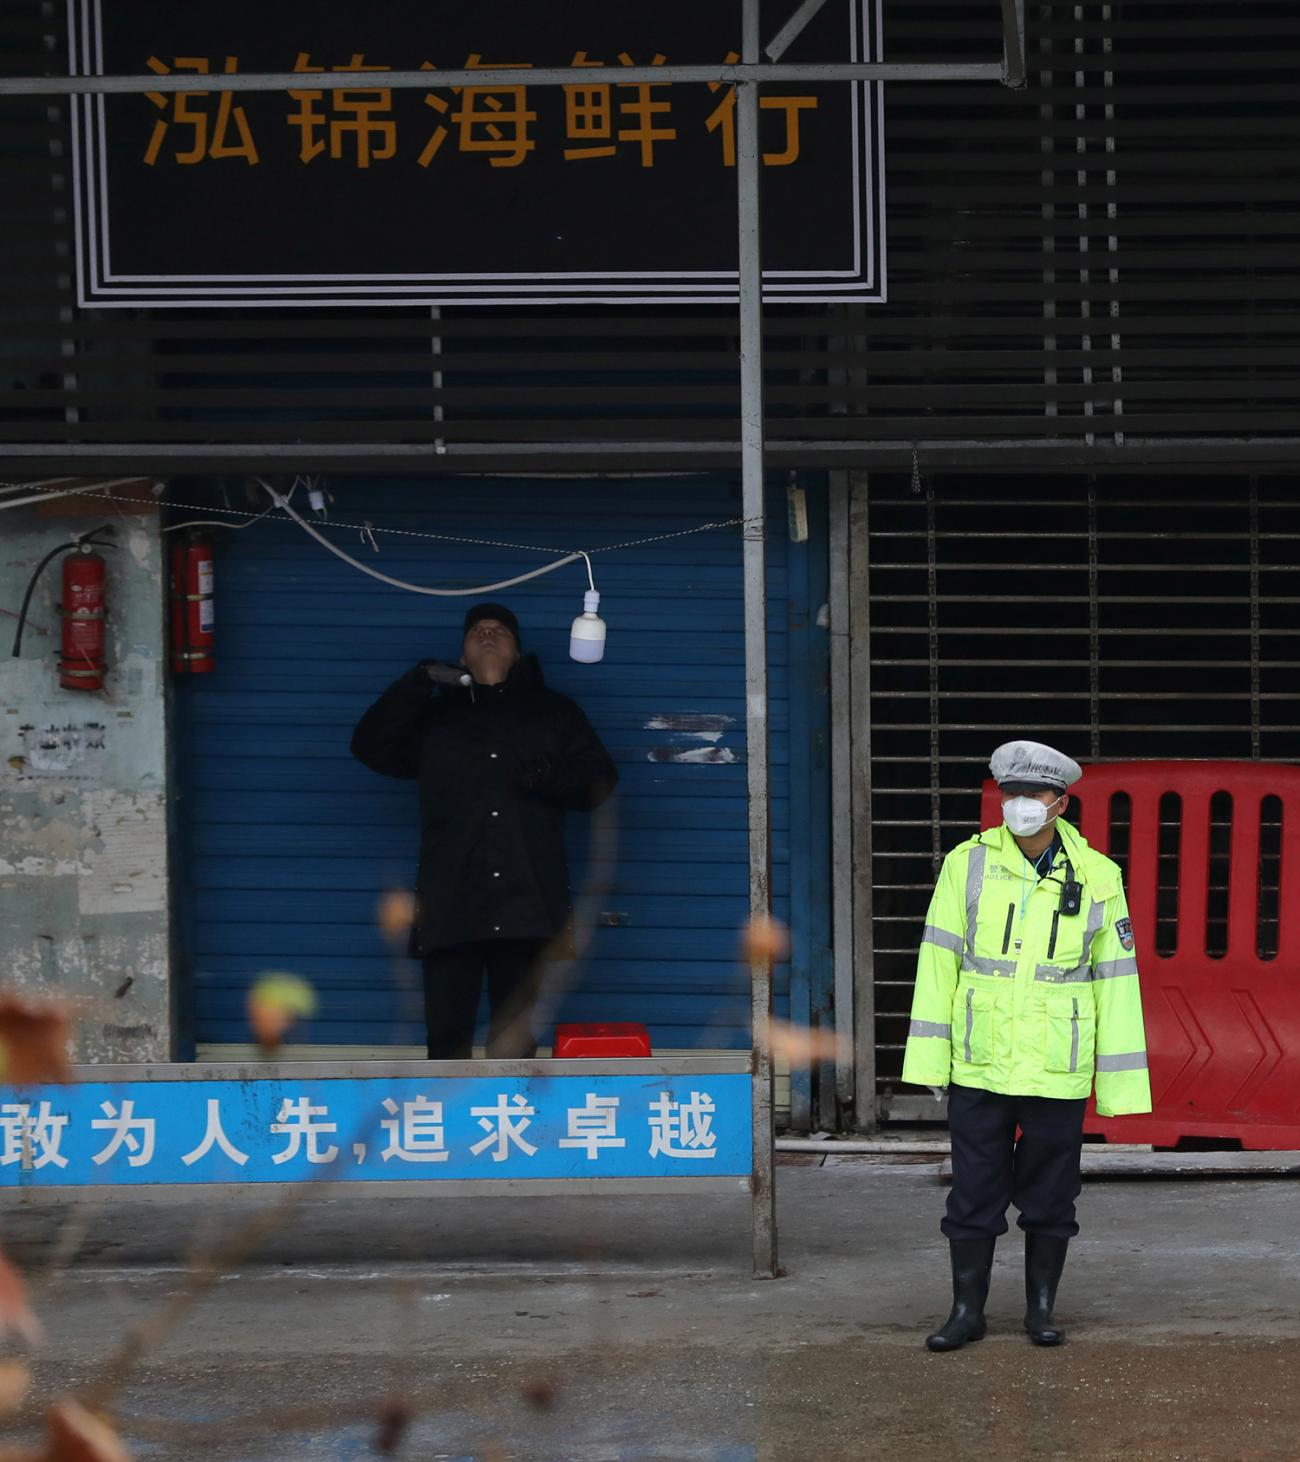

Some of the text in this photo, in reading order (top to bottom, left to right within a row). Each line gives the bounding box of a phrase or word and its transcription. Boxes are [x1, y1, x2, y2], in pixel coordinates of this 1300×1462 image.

[143, 51, 818, 168] 泓锦海鲜行
